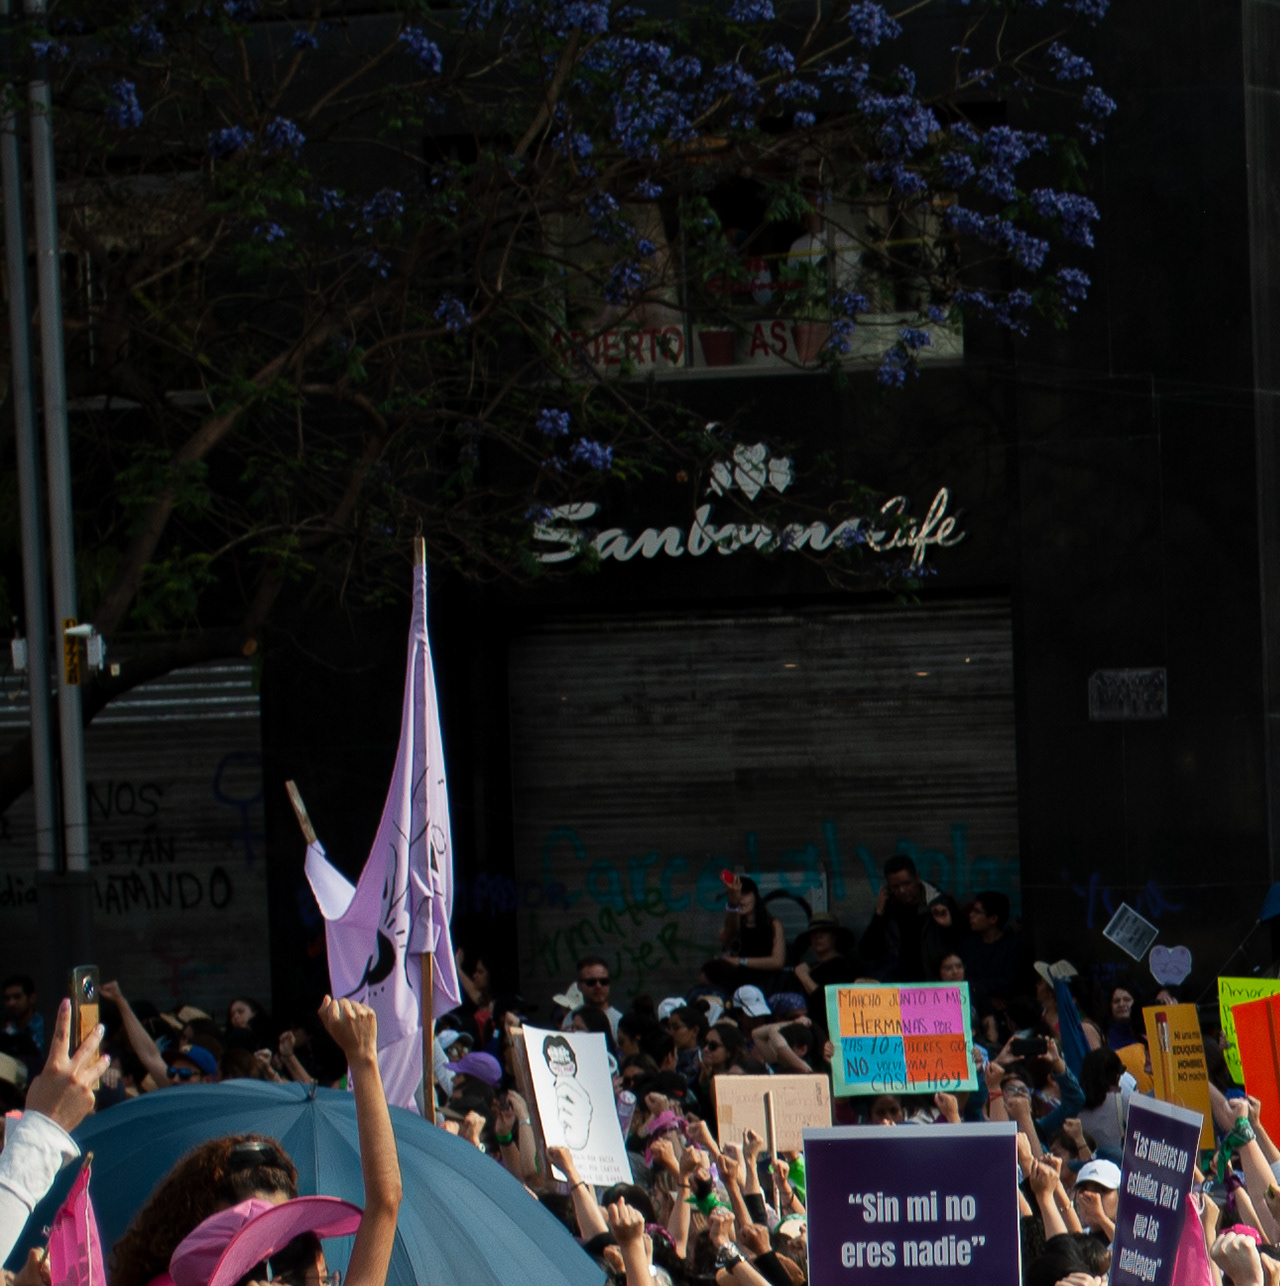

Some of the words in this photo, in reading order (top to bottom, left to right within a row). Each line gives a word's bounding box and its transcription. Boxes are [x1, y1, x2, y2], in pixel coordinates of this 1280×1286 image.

[852, 1010, 929, 1036] HERMANAS
[846, 1056, 870, 1079] NO
[871, 1071, 917, 1093] CASA
[926, 1070, 963, 1091] HOY
[848, 1190, 900, 1223] “Sin
[906, 1190, 938, 1223] mi
[945, 1194, 977, 1222] no
[840, 1239, 897, 1269] eres
[903, 1234, 987, 1268] nadie”
